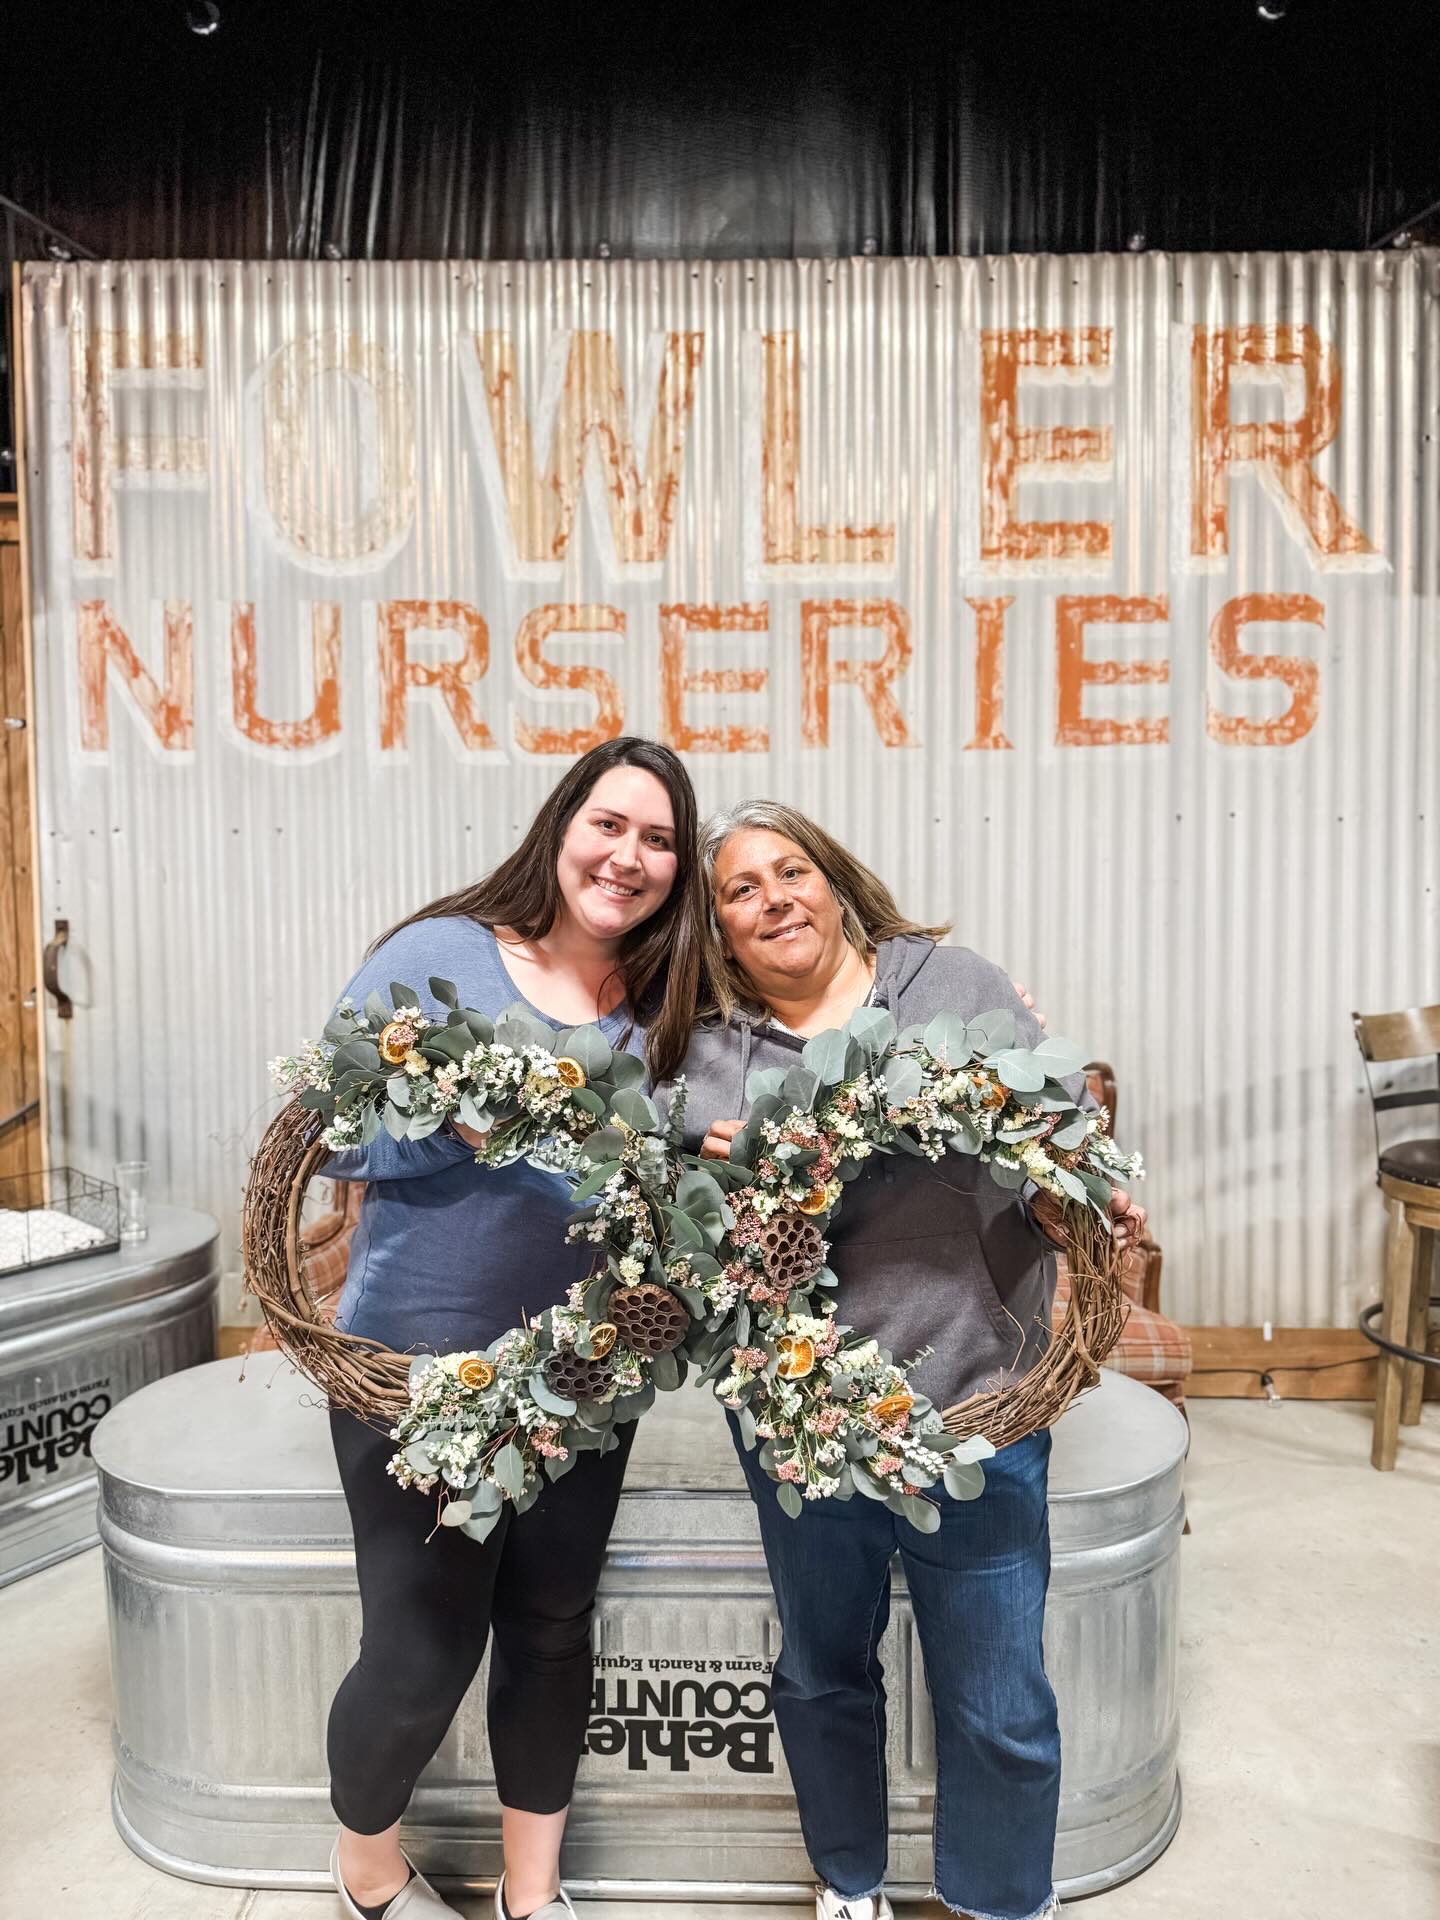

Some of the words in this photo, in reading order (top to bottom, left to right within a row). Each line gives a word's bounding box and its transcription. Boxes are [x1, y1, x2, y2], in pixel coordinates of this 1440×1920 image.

[54, 324, 1386, 578] FOWLER
[74, 593, 1326, 764] NURSERIES
[648, 1658, 706, 1673] Ranch
[709, 1659, 722, 1673] &
[725, 1660, 774, 1675] Farm
[580, 1717, 774, 1773] Behle
